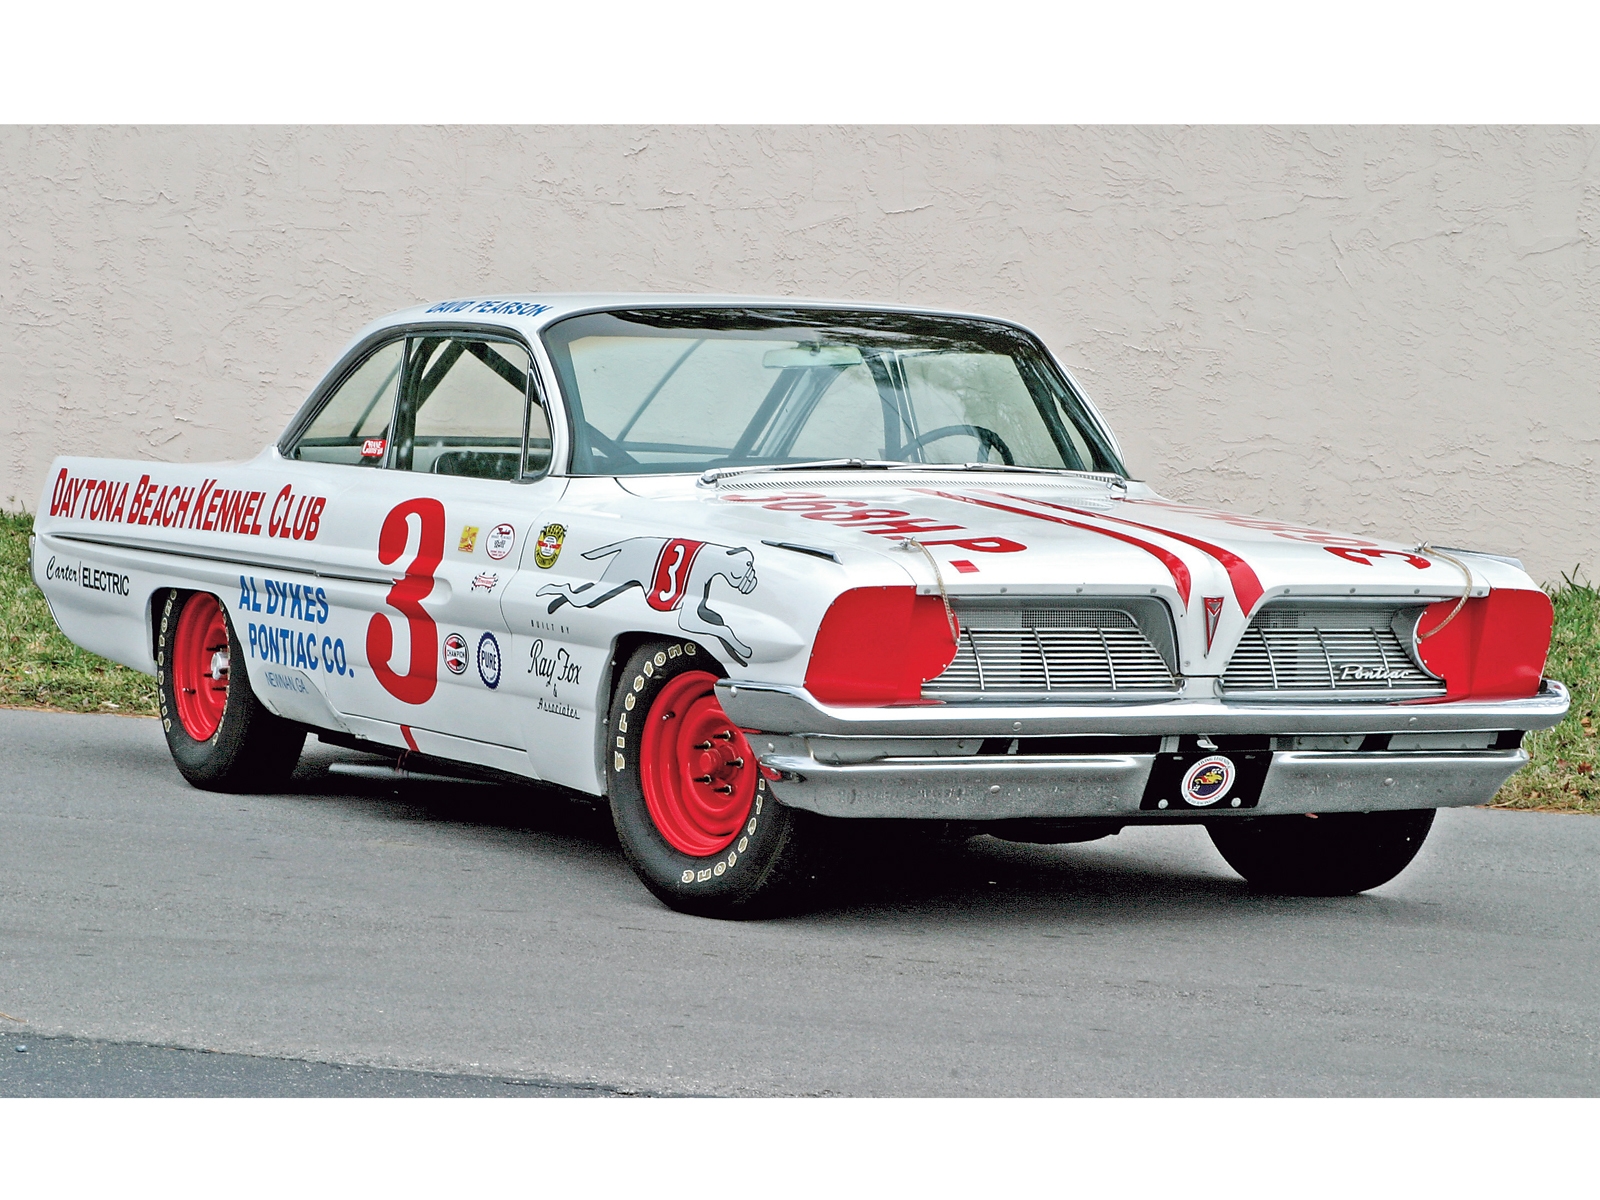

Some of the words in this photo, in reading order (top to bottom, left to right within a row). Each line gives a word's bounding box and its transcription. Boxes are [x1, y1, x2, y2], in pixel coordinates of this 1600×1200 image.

[426, 301, 477, 313] DAVID
[469, 301, 554, 317] PEARSON
[50, 468, 130, 524] DAYTONA
[127, 474, 195, 529] BEACH
[188, 479, 267, 536] KENNEL
[269, 484, 327, 541] CLUB
[46, 555, 77, 582] Carter
[83, 567, 130, 597] ELECTRIC
[659, 545, 685, 602] 3
[238, 575, 262, 613] AL
[264, 579, 329, 625] DYKES
[366, 497, 446, 705] 3
[530, 619, 555, 631] BUILT
[248, 623, 319, 671] PONTIAC
[321, 636, 355, 679] CO.
[481, 650, 497, 671] PURE
[527, 639, 556, 687] Ray
[557, 648, 582, 685] Fox
[1339, 663, 1409, 681] Pontiac
[537, 697, 581, 720] Associates
[614, 642, 697, 772] Firestone
[682, 777, 766, 884] irestone
